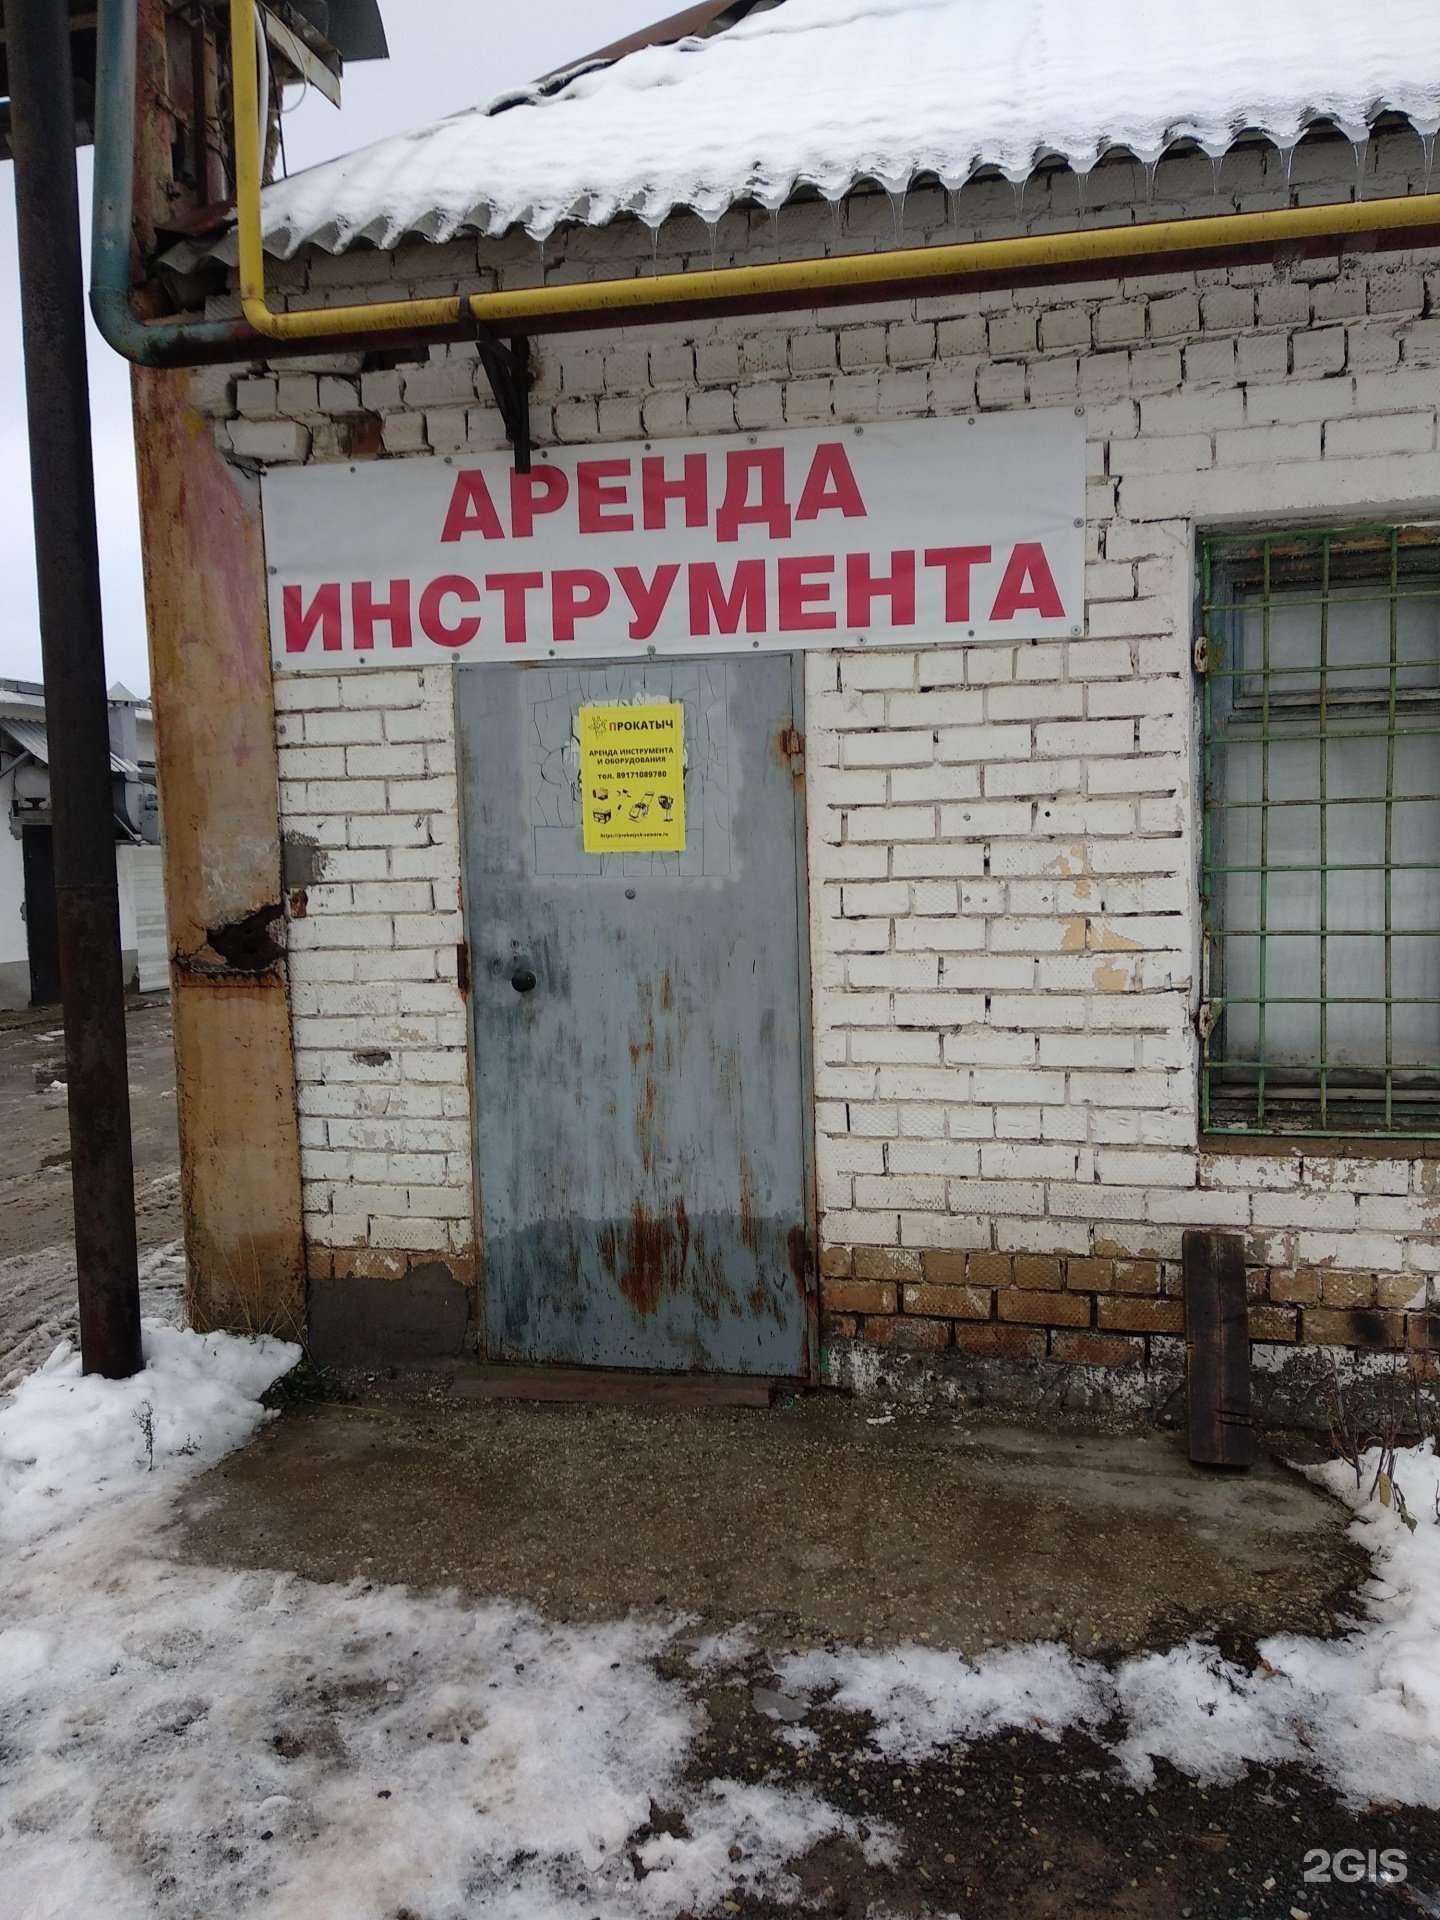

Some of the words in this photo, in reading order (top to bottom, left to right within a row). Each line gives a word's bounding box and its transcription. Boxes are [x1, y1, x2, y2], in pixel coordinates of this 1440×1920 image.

[440, 442, 868, 543] АРЕНДА
[282, 542, 1066, 653] ИНСТРУМЕНТА
[609, 720, 674, 731] ПРОКАТЫЧ
[589, 749, 618, 757] АРЕНДА
[620, 747, 674, 756] ИНСТРУМЕНТА
[605, 757, 666, 765] ОБОРУДОВАНИЯ
